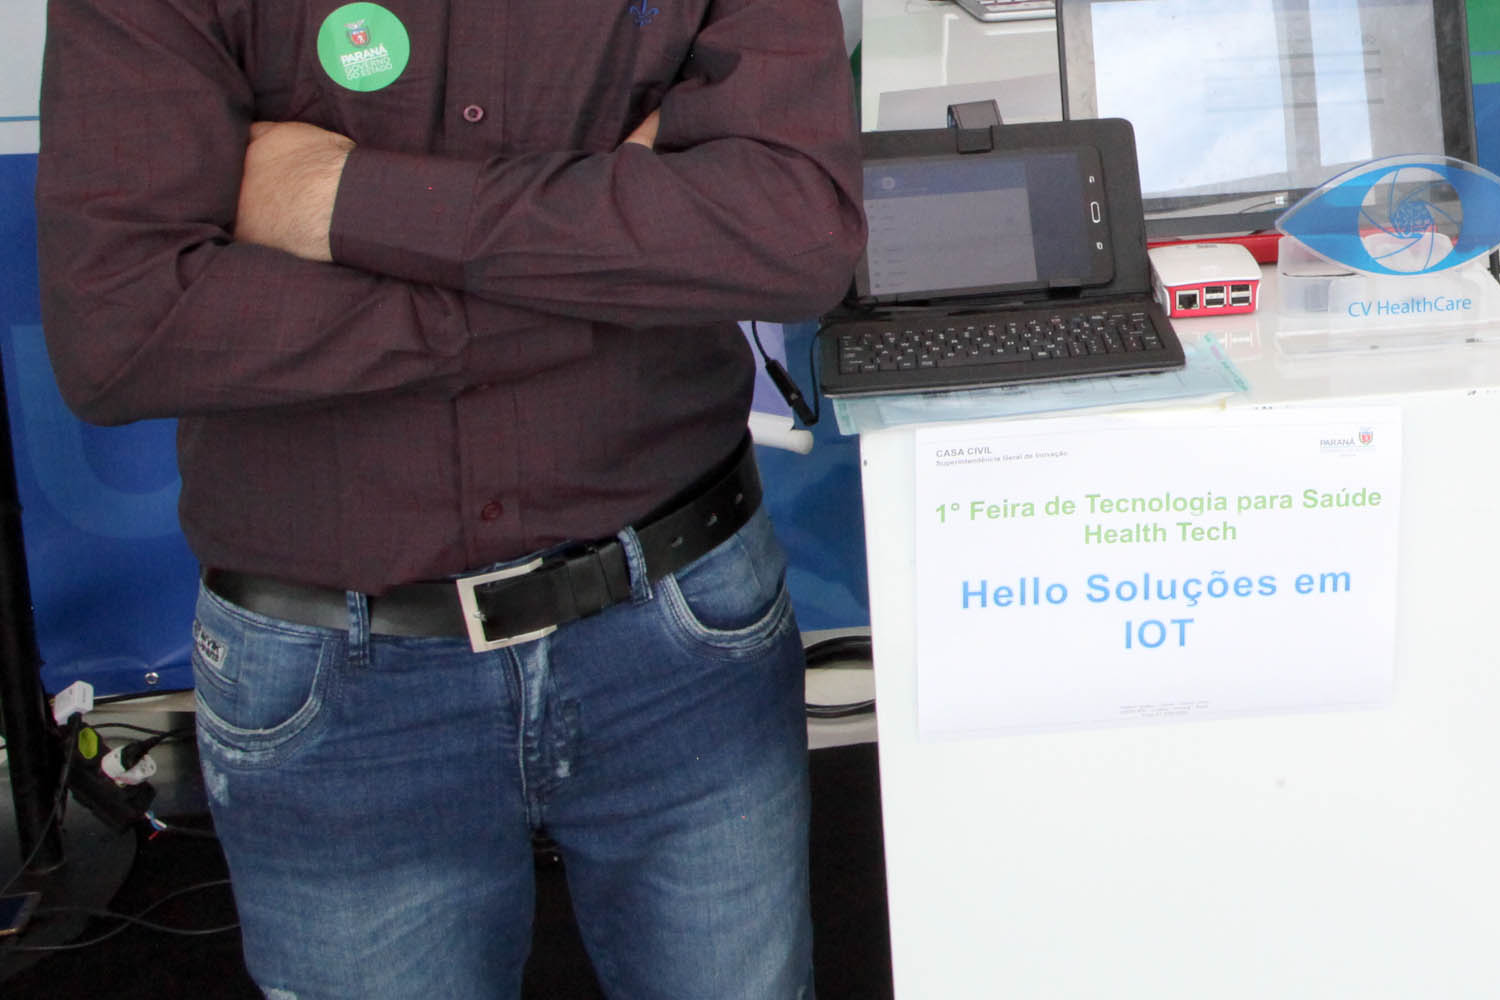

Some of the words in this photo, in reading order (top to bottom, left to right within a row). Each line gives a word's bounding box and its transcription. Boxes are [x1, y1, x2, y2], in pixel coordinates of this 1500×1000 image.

[340, 43, 389, 65] PARANÁ
[1348, 301, 1372, 318] CV
[1377, 296, 1473, 316] HealthCare
[936, 448, 965, 458] CASA
[967, 446, 993, 456] CIVIL
[969, 499, 1035, 521] Feira
[1044, 495, 1076, 516] de
[1086, 492, 1228, 517] Tecnologia
[1237, 495, 1293, 514] para
[1302, 486, 1383, 510] Saúde
[1084, 523, 1168, 546] Health
[1177, 521, 1237, 542] Tech
[960, 575, 1070, 610] Hello
[1085, 568, 1279, 609] Soluções
[1292, 571, 1353, 597] em
[1124, 617, 1196, 651] IOT
